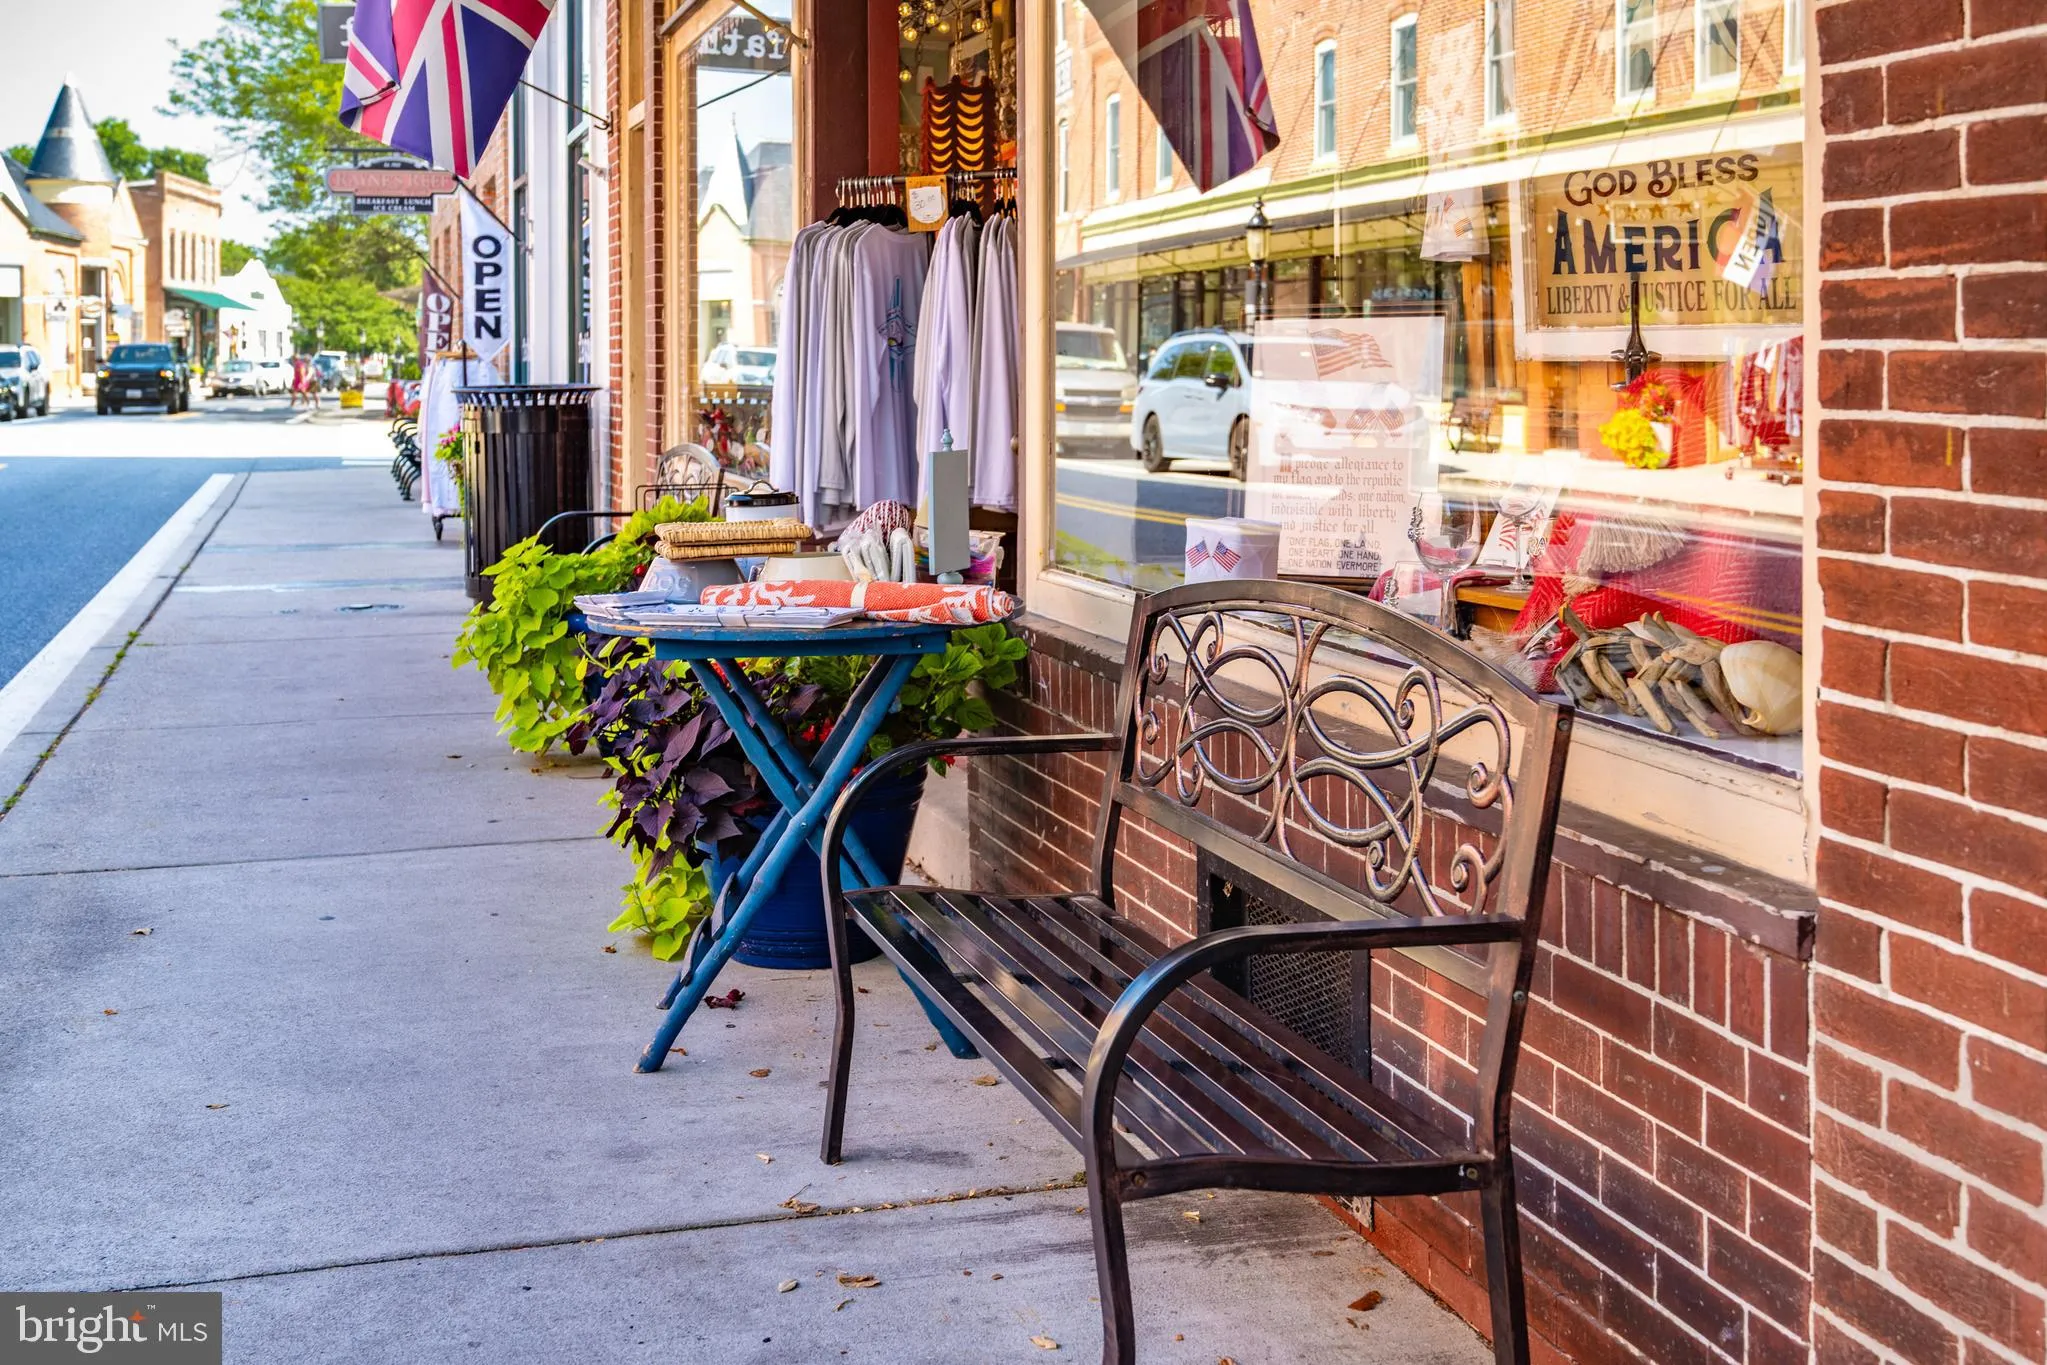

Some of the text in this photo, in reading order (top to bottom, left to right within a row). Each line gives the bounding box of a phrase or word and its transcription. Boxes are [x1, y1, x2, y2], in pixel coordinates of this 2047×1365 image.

[1564, 153, 1759, 207] GOD BLESS
[356, 197, 432, 205] BREAKFAST LUNCH
[1552, 187, 1787, 276] AMERICA
[473, 235, 502, 339] OPEN
[1546, 284, 1614, 315] LIBERTY
[1618, 283, 1631, 313] &
[1711, 279, 1753, 312] FOR
[1758, 276, 1797, 311] ALL
[425, 293, 452, 368] OPE
[1334, 456, 1391, 471] allegiance
[1393, 457, 1404, 471] to
[1314, 472, 1333, 486] and
[1346, 472, 1361, 487] the
[1362, 473, 1403, 490] republic
[1327, 503, 1353, 517] with
[1358, 503, 1397, 520] liberty
[1299, 518, 1340, 533] justice
[1342, 519, 1359, 533] for
[1334, 539, 1352, 549] ONE
[1288, 547, 1306, 557] ONE
[1338, 550, 1355, 560] ONE
[1288, 559, 1305, 568] ONE
